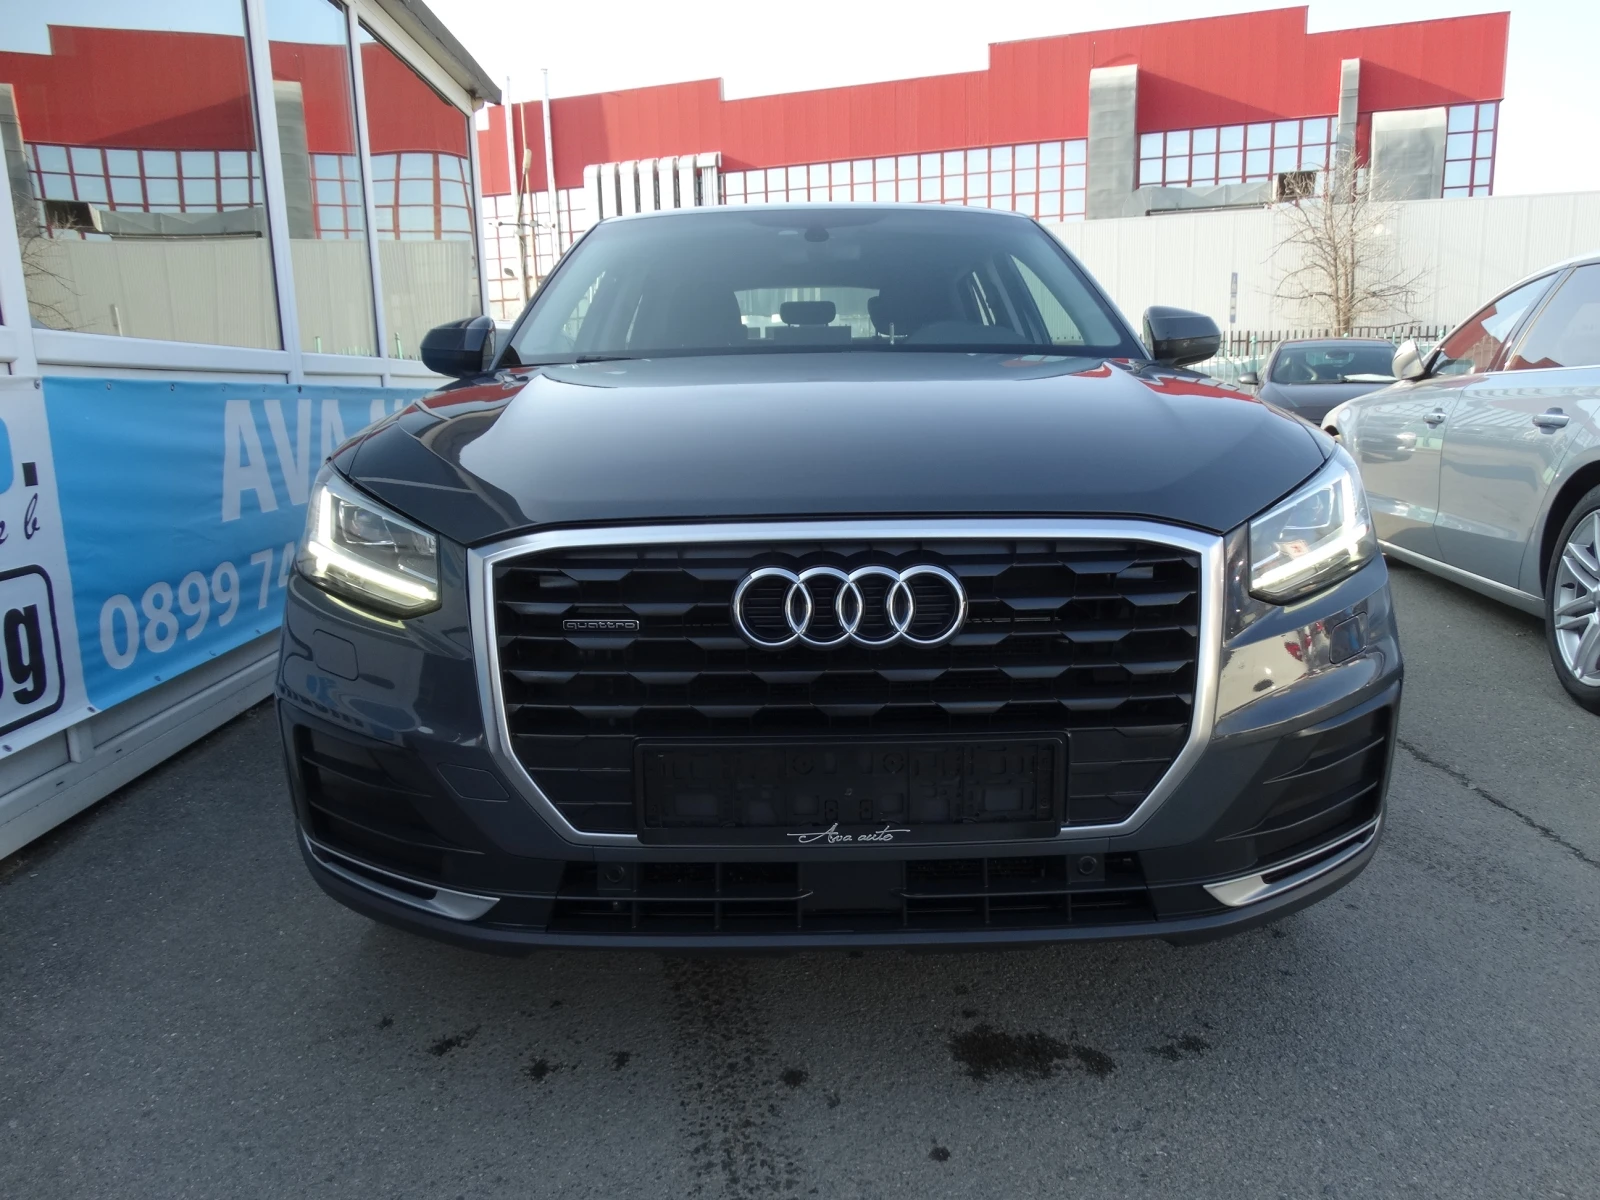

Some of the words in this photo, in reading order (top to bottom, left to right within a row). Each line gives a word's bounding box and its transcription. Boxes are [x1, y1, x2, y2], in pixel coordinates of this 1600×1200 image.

[99, 560, 240, 670] 0899
[566, 621, 636, 630] quattro
[0, 603, 47, 705] g
[786, 822, 853, 843] Ava
[857, 825, 911, 841] auto
